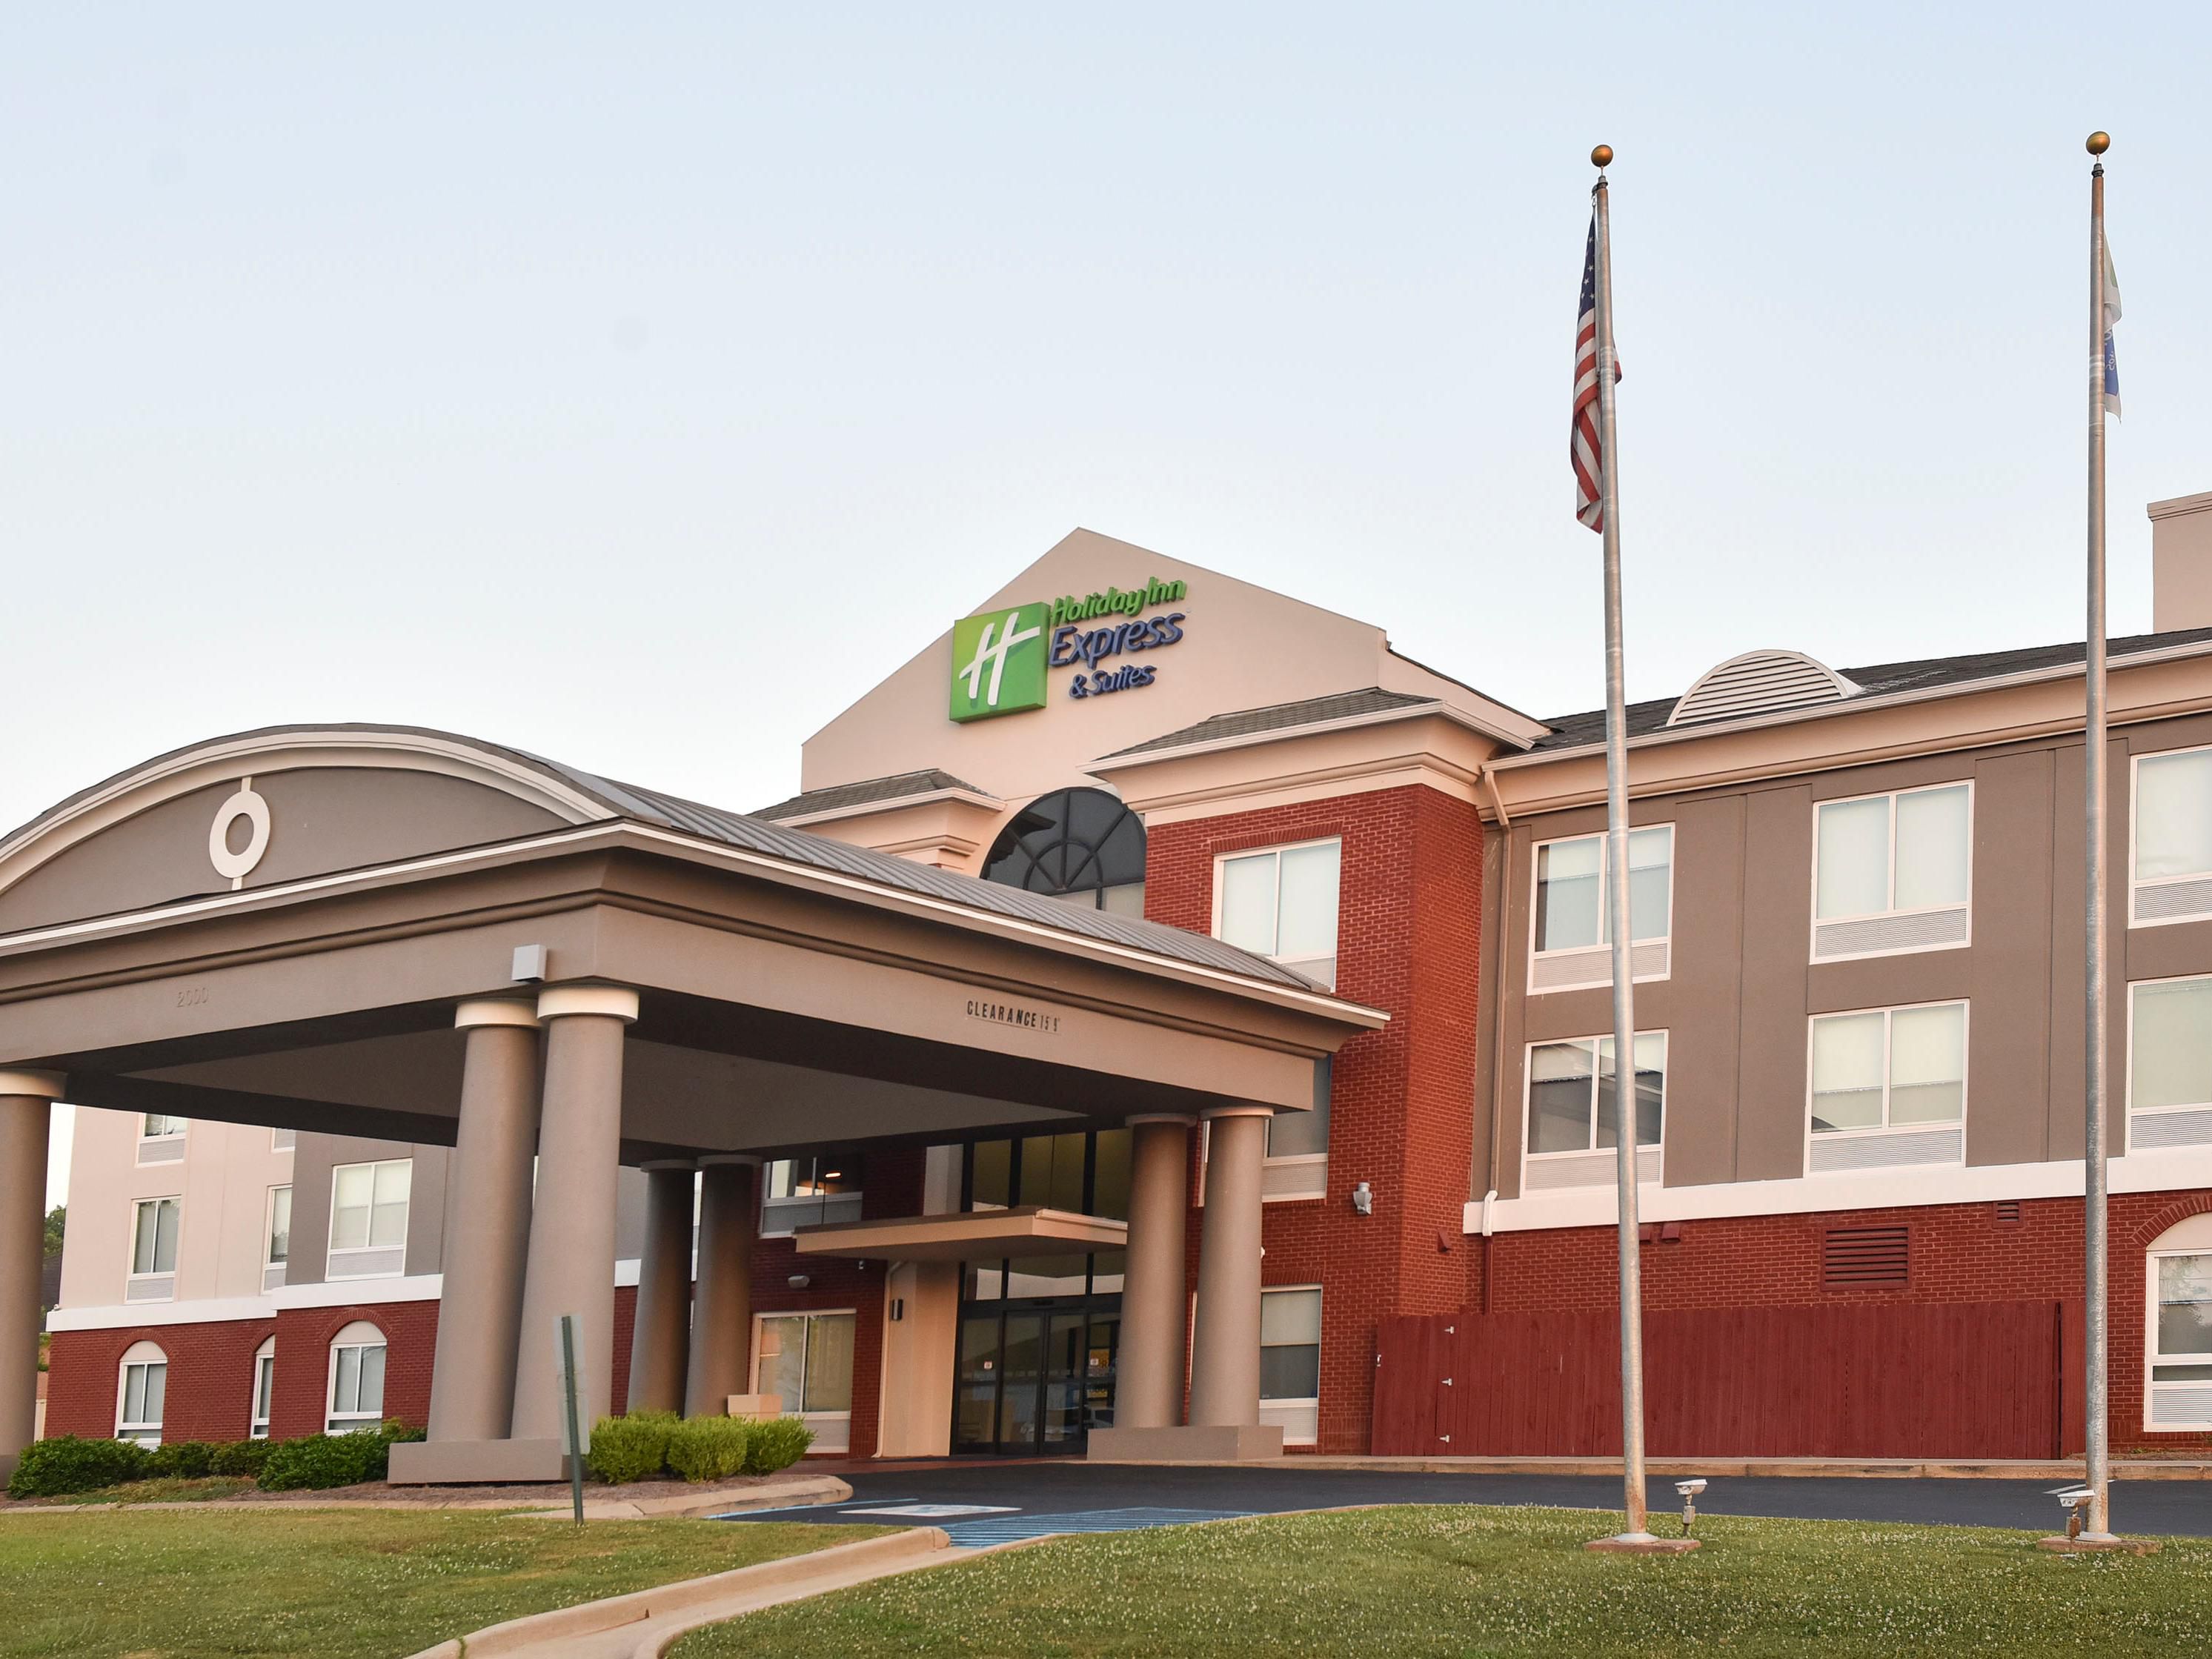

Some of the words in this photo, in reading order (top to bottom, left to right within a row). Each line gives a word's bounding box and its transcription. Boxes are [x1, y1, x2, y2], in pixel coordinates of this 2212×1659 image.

[1051, 587, 1146, 626] Holiday
[1148, 576, 1186, 605] Inn
[1049, 613, 1186, 671] Express
[1069, 674, 1089, 699] &
[1090, 665, 1158, 695] Suites
[967, 1000, 1037, 1027] CLEARANCE
